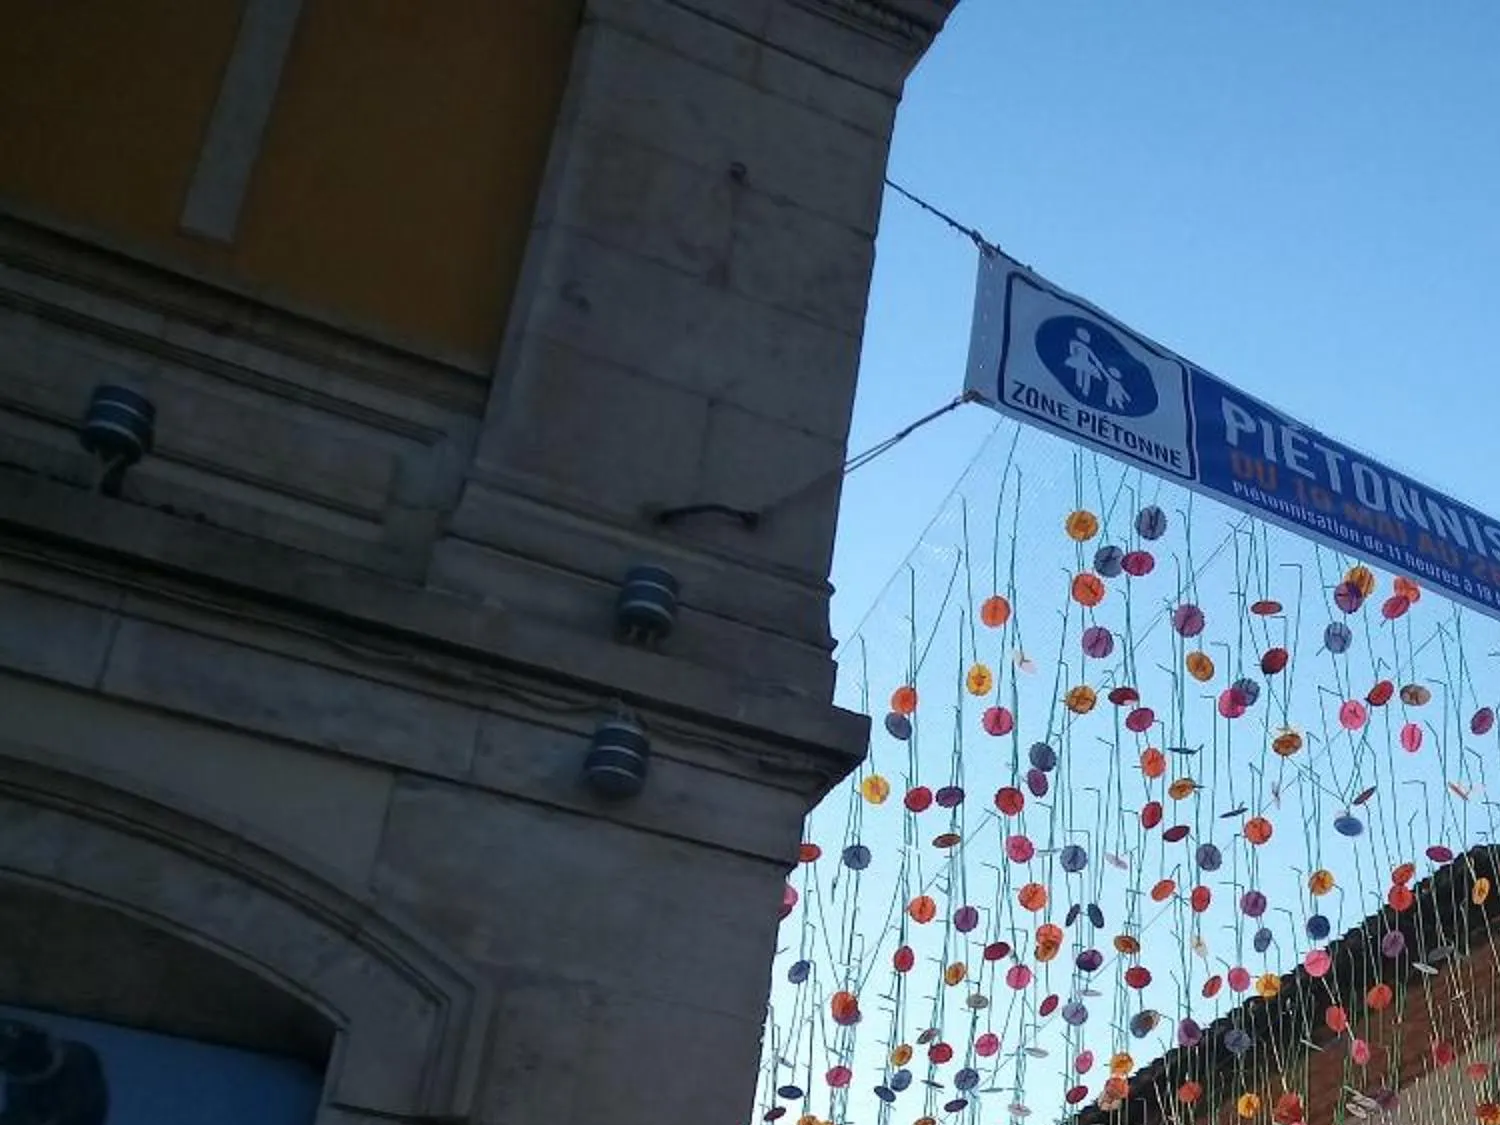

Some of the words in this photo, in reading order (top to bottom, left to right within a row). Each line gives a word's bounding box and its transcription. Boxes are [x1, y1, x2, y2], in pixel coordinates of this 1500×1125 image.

[1012, 379, 1071, 422] ZONE
[1076, 409, 1184, 471] PIÉTONNE
[1229, 450, 1279, 492] DU
[1405, 551, 1461, 588] heures
